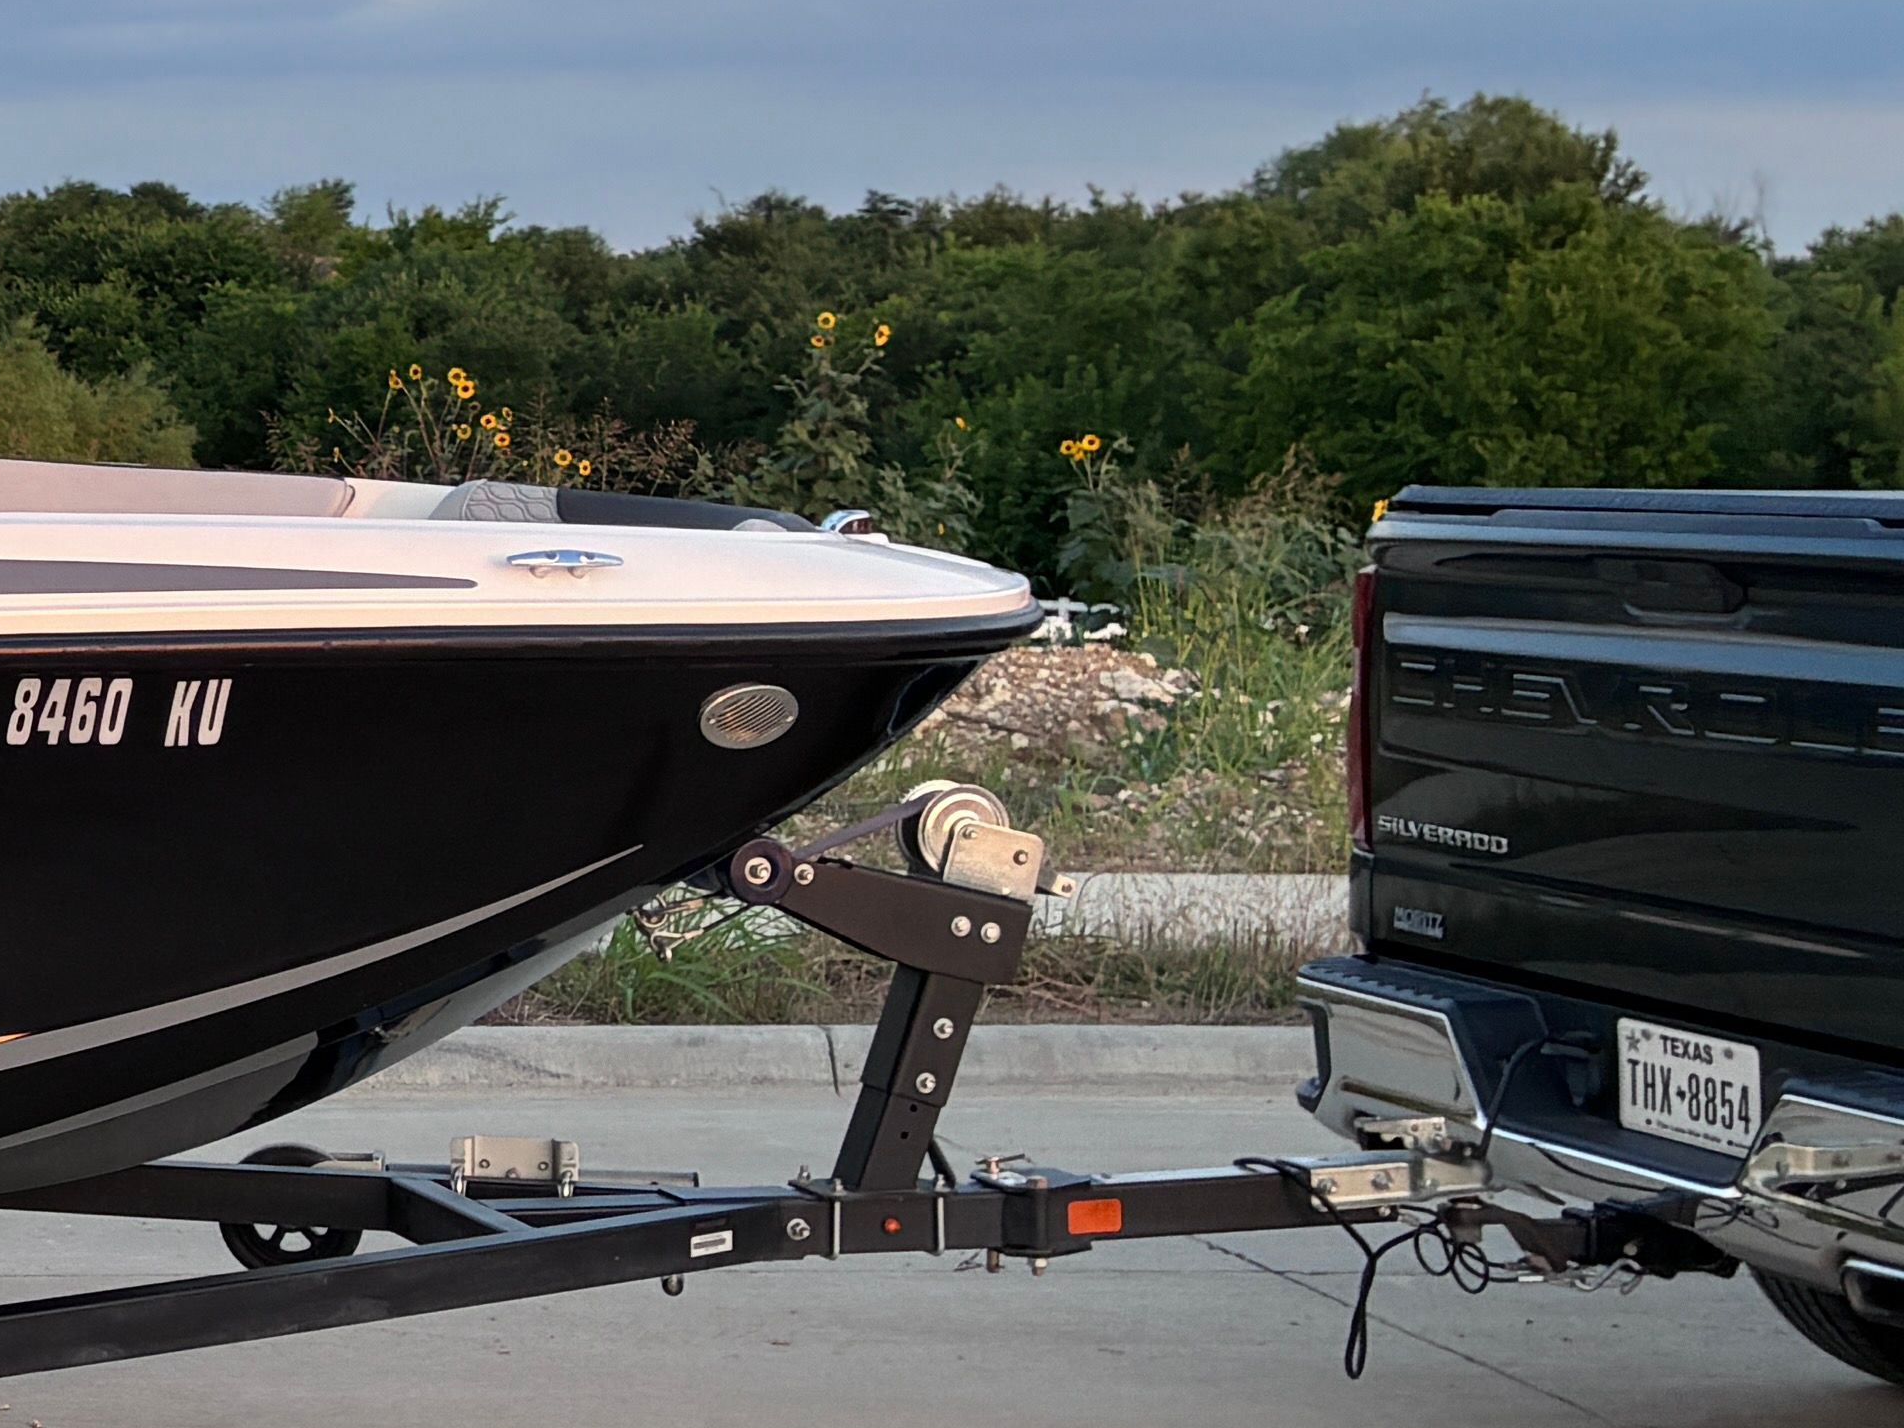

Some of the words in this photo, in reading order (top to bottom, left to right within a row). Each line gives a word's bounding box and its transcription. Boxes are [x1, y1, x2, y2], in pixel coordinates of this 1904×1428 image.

[6, 677, 133, 746] 8460
[164, 678, 233, 747] KU
[1377, 815, 1508, 855] SILVERADO
[1659, 1034, 1714, 1065] TEXAS
[1627, 1058, 1672, 1116] THX
[1687, 1072, 1752, 1135] 8854
